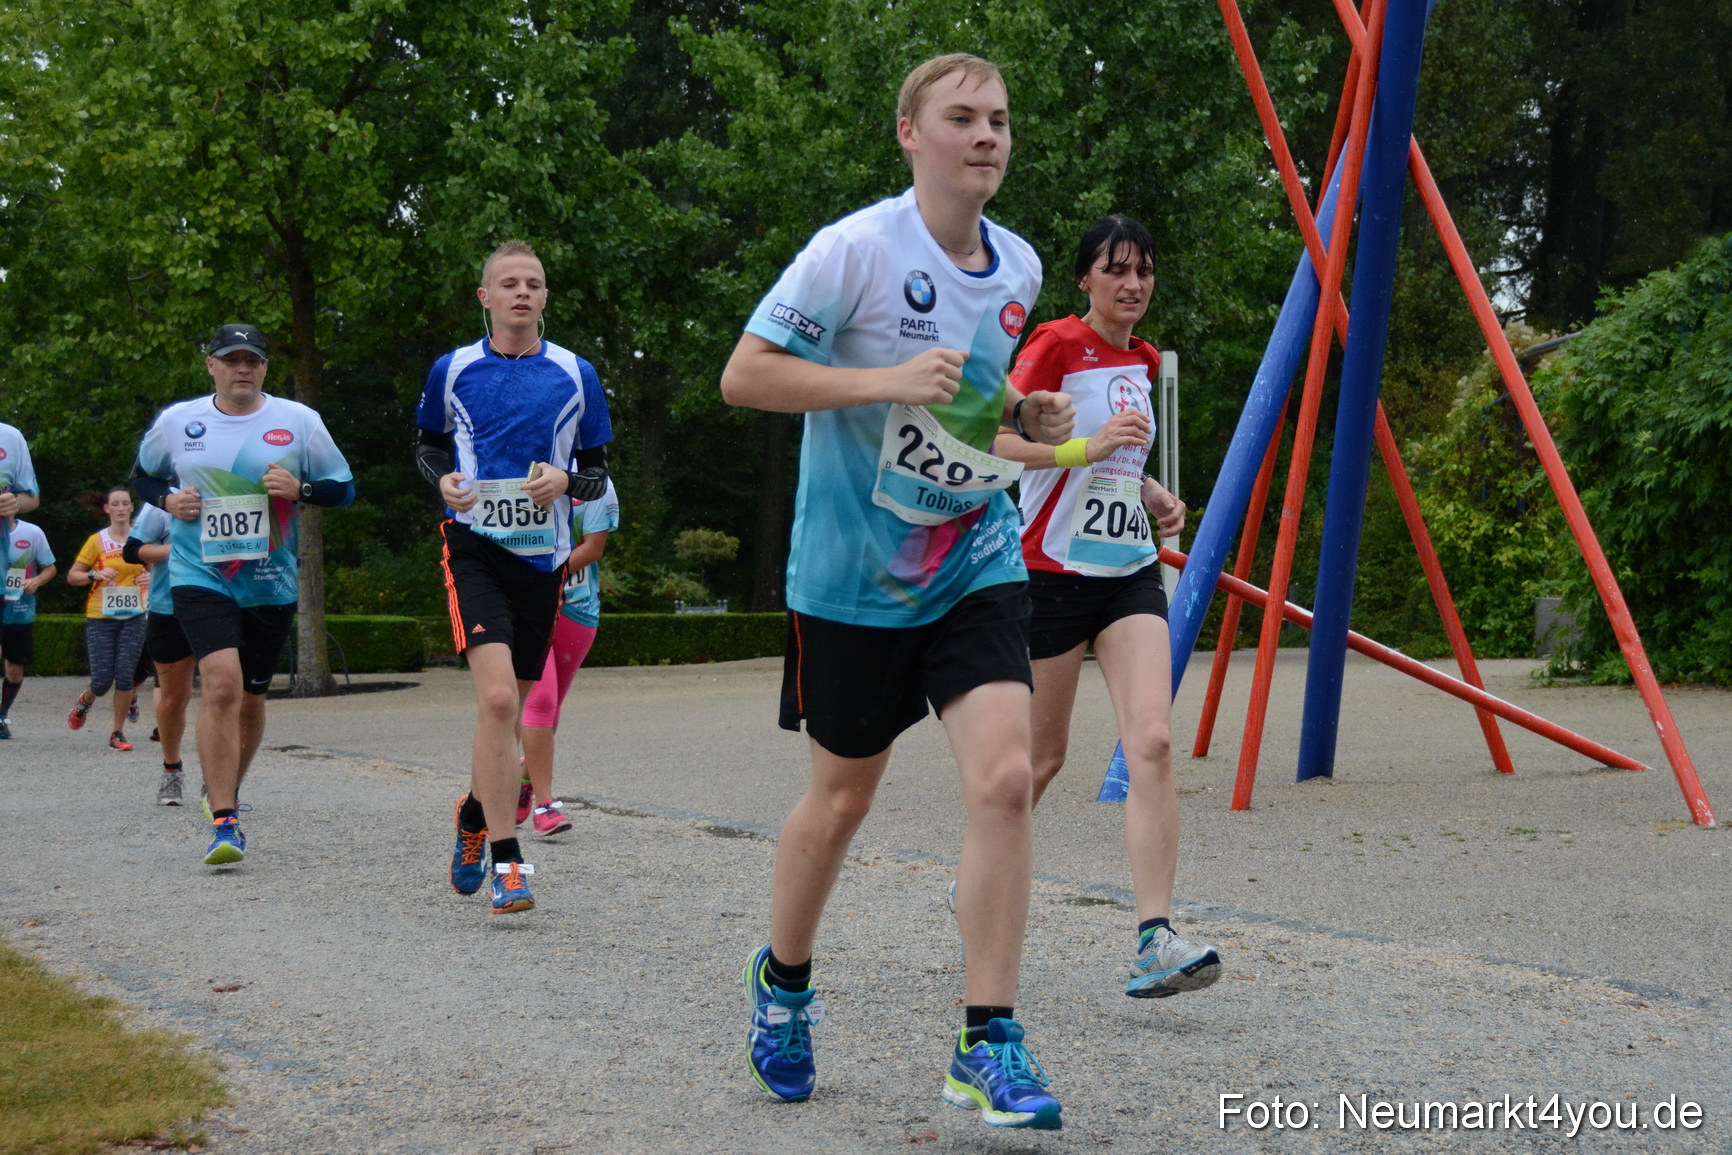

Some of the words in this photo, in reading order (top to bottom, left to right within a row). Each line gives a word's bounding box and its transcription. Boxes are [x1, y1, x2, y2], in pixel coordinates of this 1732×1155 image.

[771, 303, 827, 342] BOCK
[900, 318, 939, 333] PARTL
[899, 330, 940, 342] Neumarkt
[886, 461, 892, 469] D
[916, 486, 973, 513] Tobias
[207, 511, 263, 538] 3087
[1074, 530, 1080, 538] A
[107, 595, 138, 608] 2683
